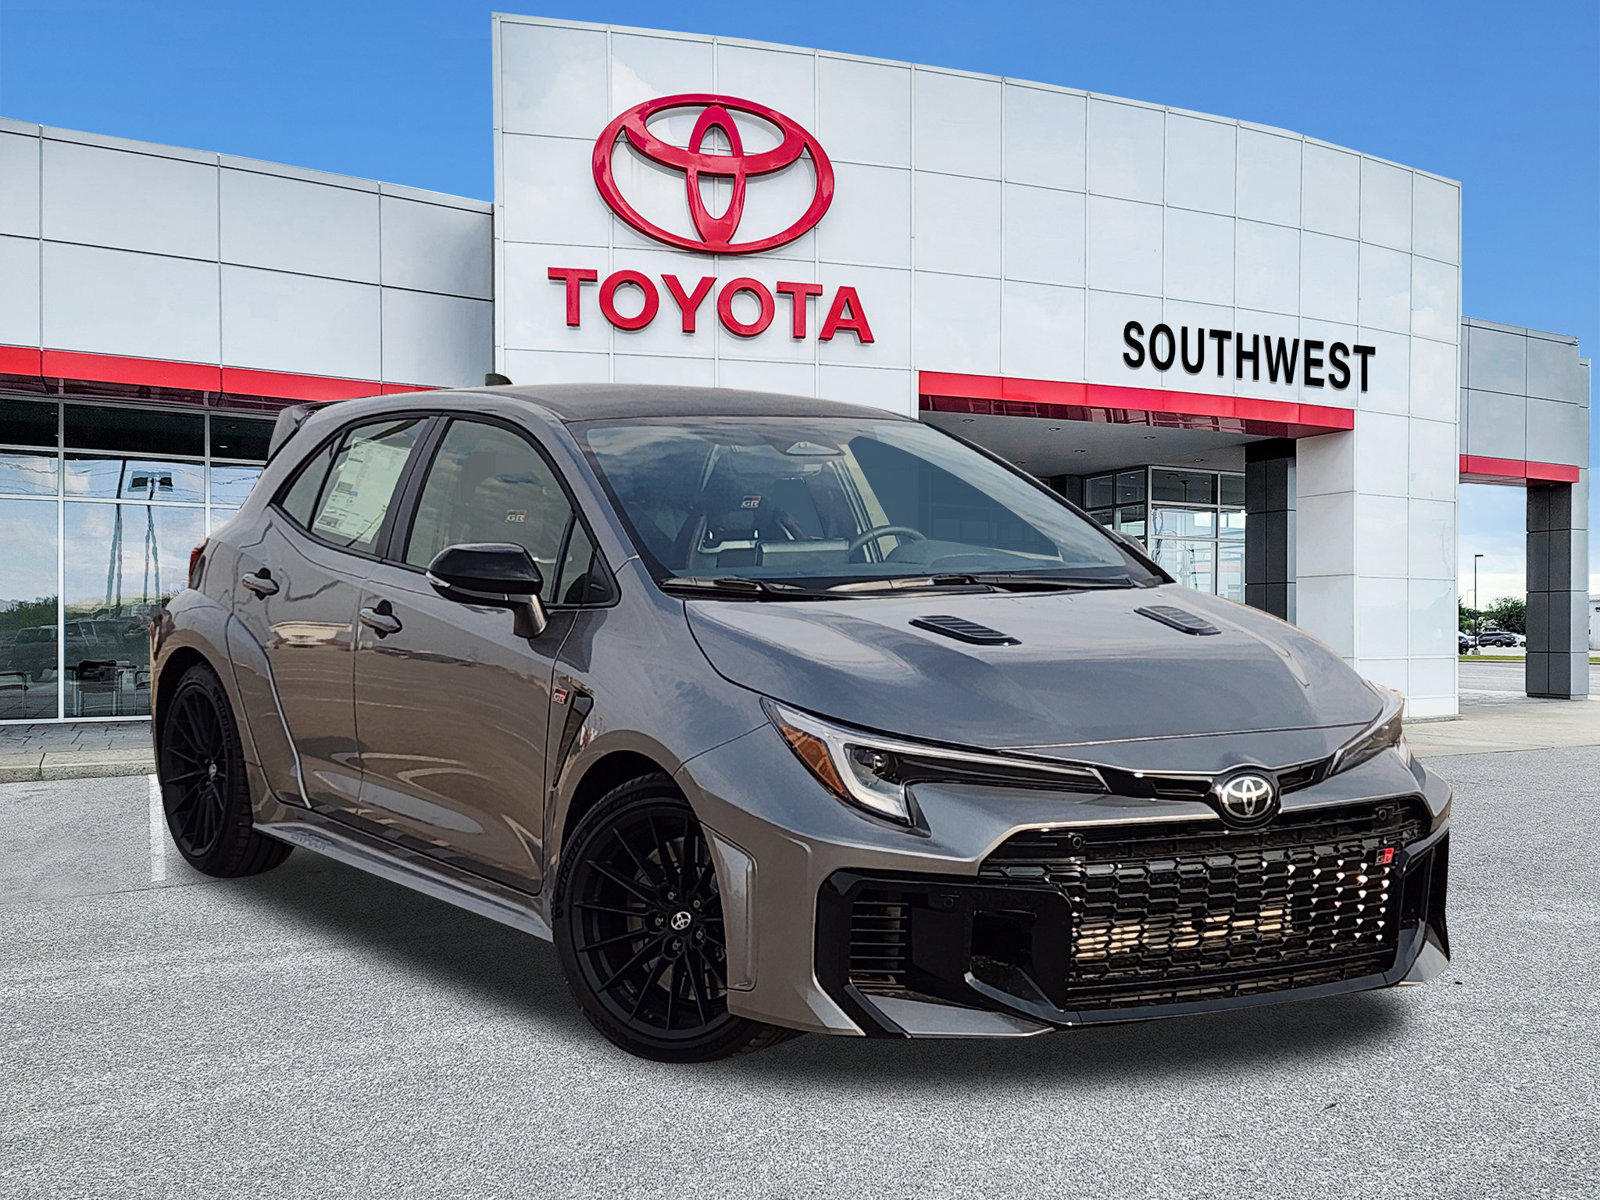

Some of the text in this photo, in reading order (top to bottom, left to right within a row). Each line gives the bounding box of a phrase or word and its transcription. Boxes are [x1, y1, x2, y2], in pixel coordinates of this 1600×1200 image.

[548, 266, 875, 343] TOYOTA
[1123, 320, 1376, 392] SOUTHWEST
[741, 497, 761, 508] GR
[504, 511, 526, 522] GR
[553, 689, 567, 704] GR
